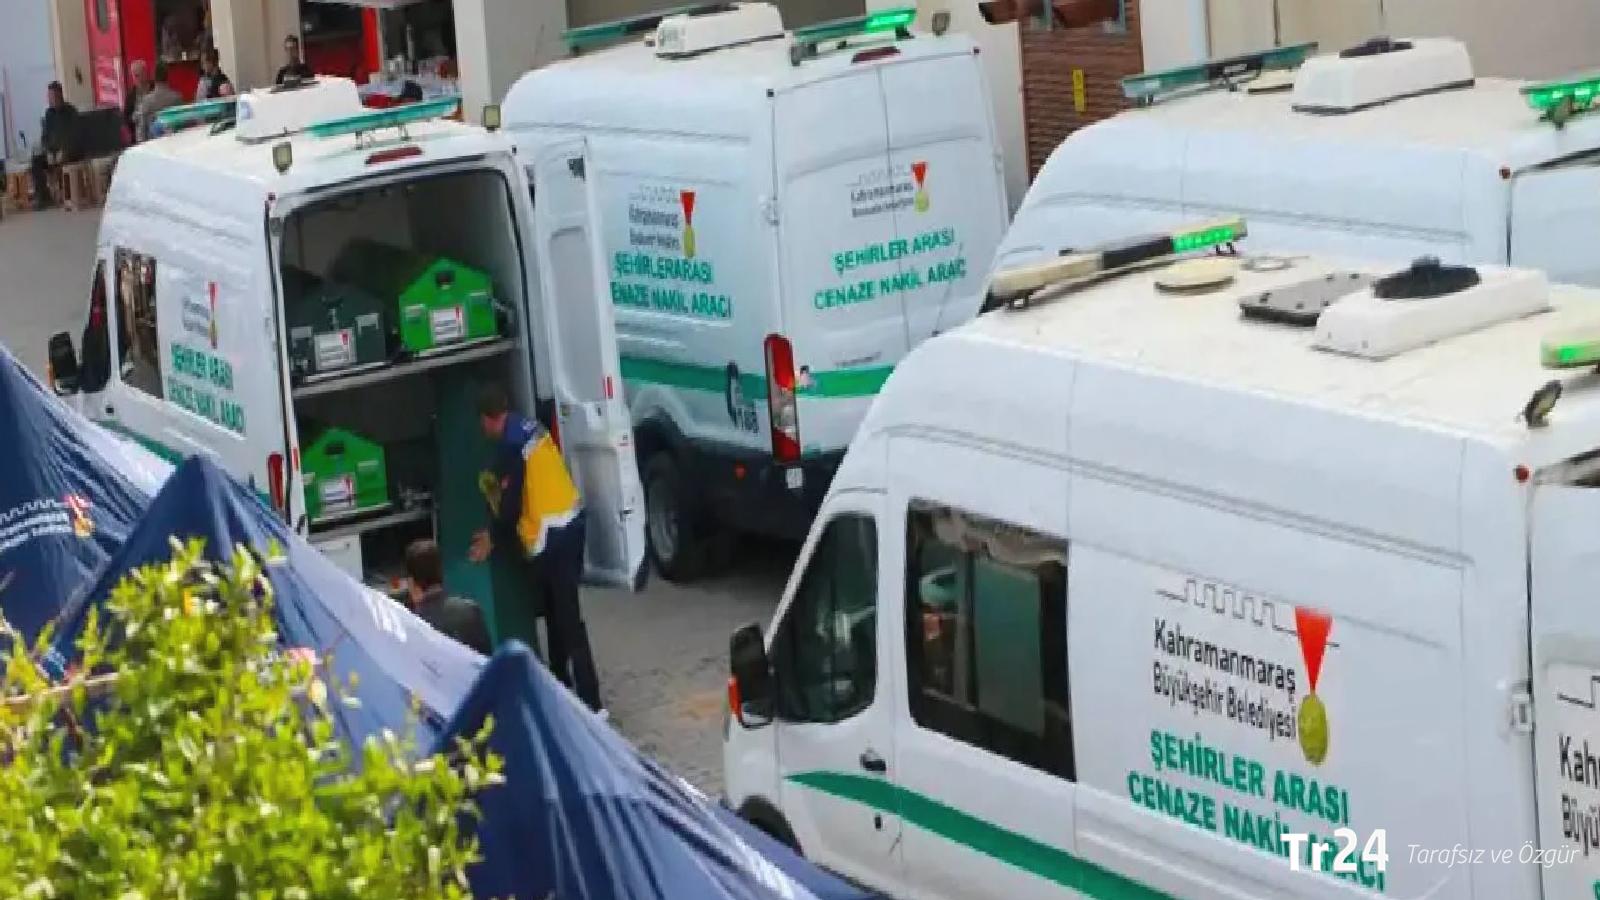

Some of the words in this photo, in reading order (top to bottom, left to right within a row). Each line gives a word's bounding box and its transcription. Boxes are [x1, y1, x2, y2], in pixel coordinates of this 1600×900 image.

[610, 281, 650, 308] ENAZE
[1154, 617, 1296, 704] Kahramanmaraş
[1153, 661, 1223, 716] Büyükşehir
[1226, 686, 1296, 741] Belediyesi
[1151, 731, 1266, 797] ŞEHİRLER
[1273, 769, 1349, 827] ARASI
[1559, 733, 1600, 790] Kah
[1127, 770, 1217, 831] CENAZE
